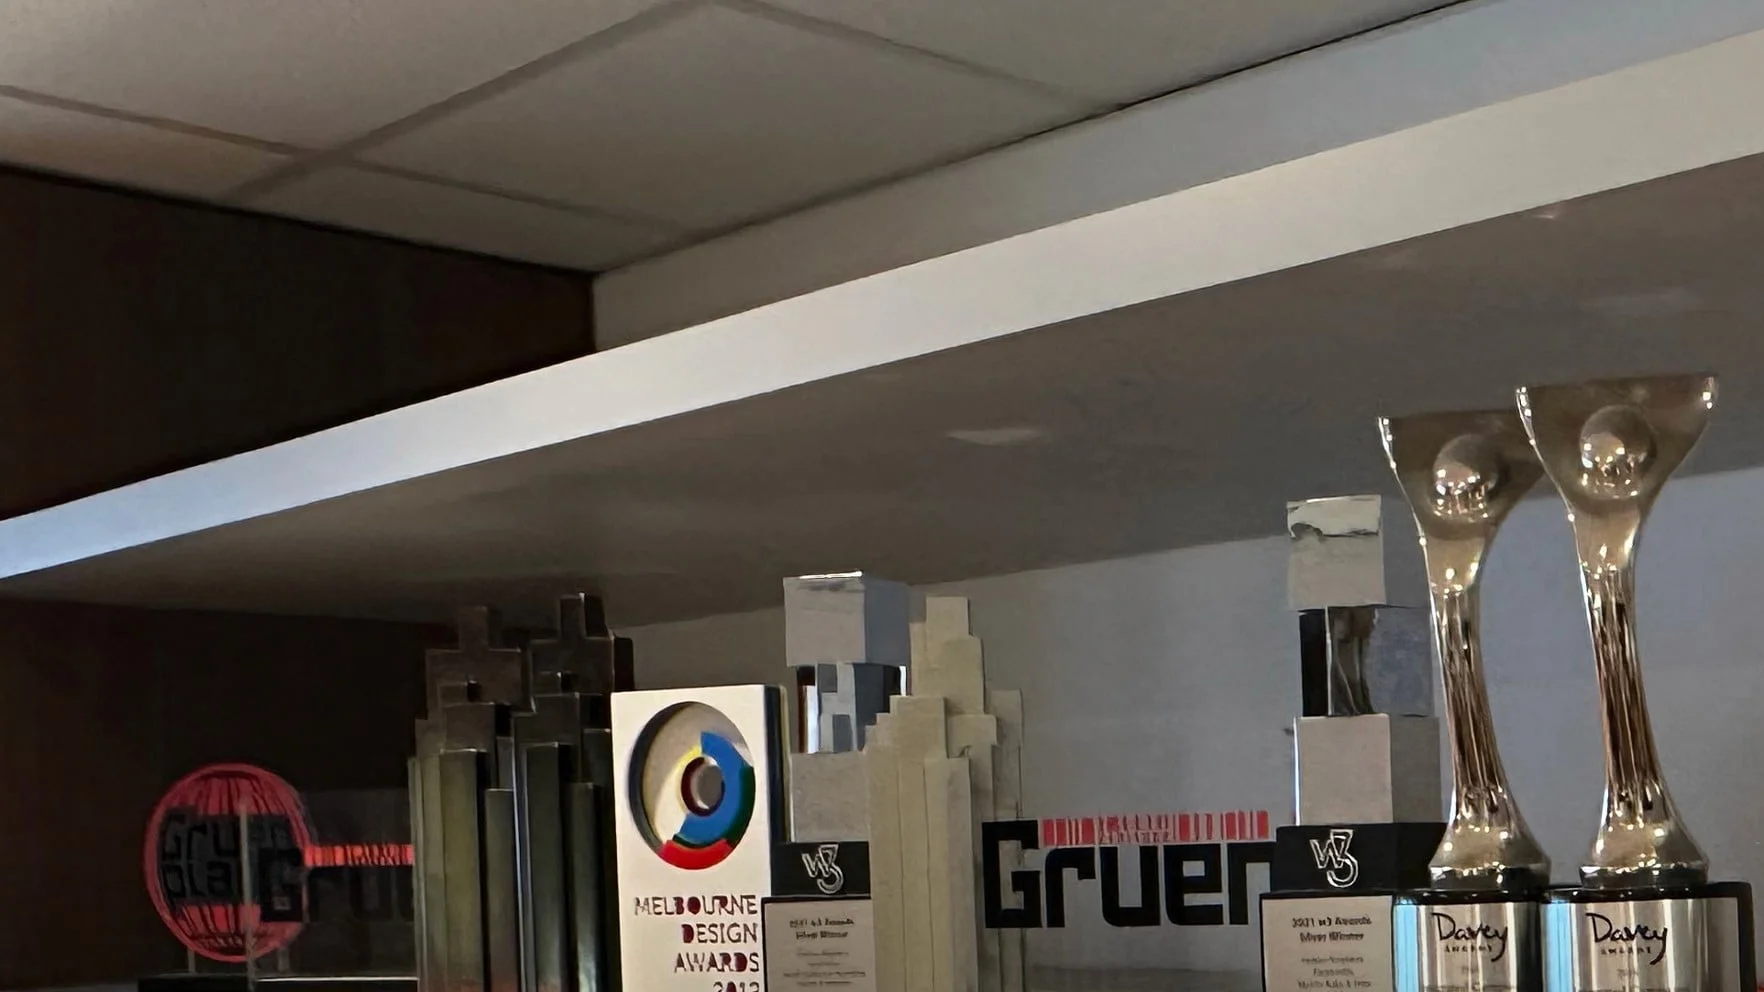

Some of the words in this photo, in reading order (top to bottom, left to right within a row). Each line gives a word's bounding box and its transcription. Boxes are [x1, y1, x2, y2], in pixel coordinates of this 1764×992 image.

[633, 894, 758, 916] MELBOURNE
[681, 922, 758, 943] DESIGN
[1431, 912, 1509, 962] Davey
[1585, 912, 1668, 965] Davey
[674, 952, 760, 973] AWARDS
